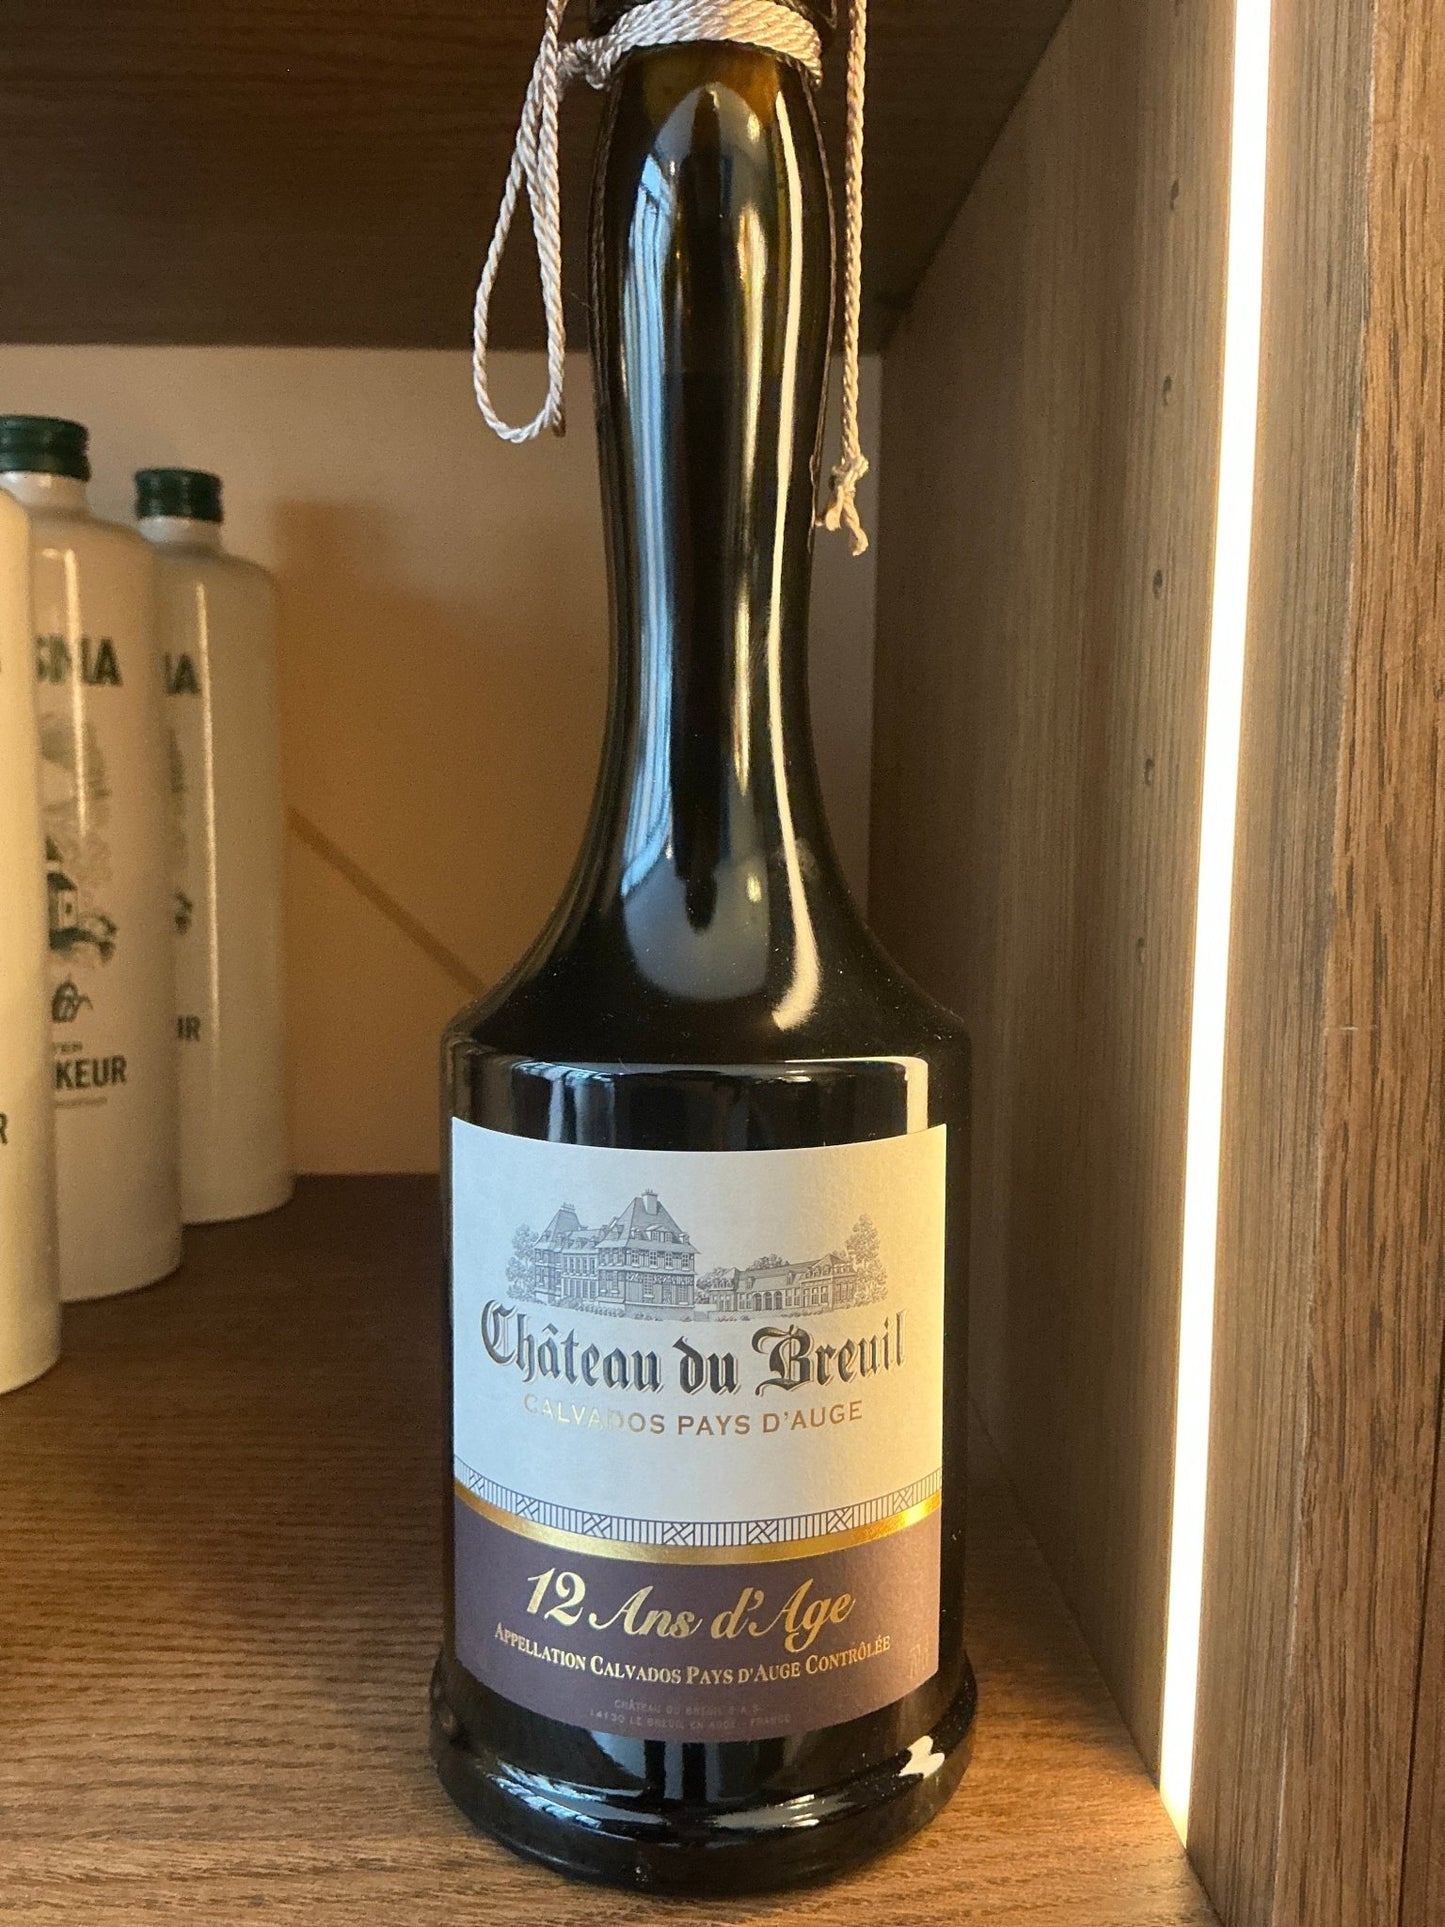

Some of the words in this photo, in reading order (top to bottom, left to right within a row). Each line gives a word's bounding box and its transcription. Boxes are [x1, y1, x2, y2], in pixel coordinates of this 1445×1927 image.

[481, 1299, 663, 1393] Château
[673, 1336, 740, 1395] du
[752, 1310, 908, 1396] Breuil
[523, 1393, 665, 1434] CALVADOS
[677, 1414, 751, 1436] PAYS
[762, 1400, 863, 1433] D'AUGE
[527, 1567, 586, 1625] 12
[588, 1585, 702, 1639] Ans
[710, 1578, 855, 1653] d'Age
[494, 1622, 586, 1671] APPELLATION
[590, 1655, 681, 1685] CALVADOS
[686, 1667, 733, 1685] PAYS
[738, 1661, 800, 1684] D'AUGE
